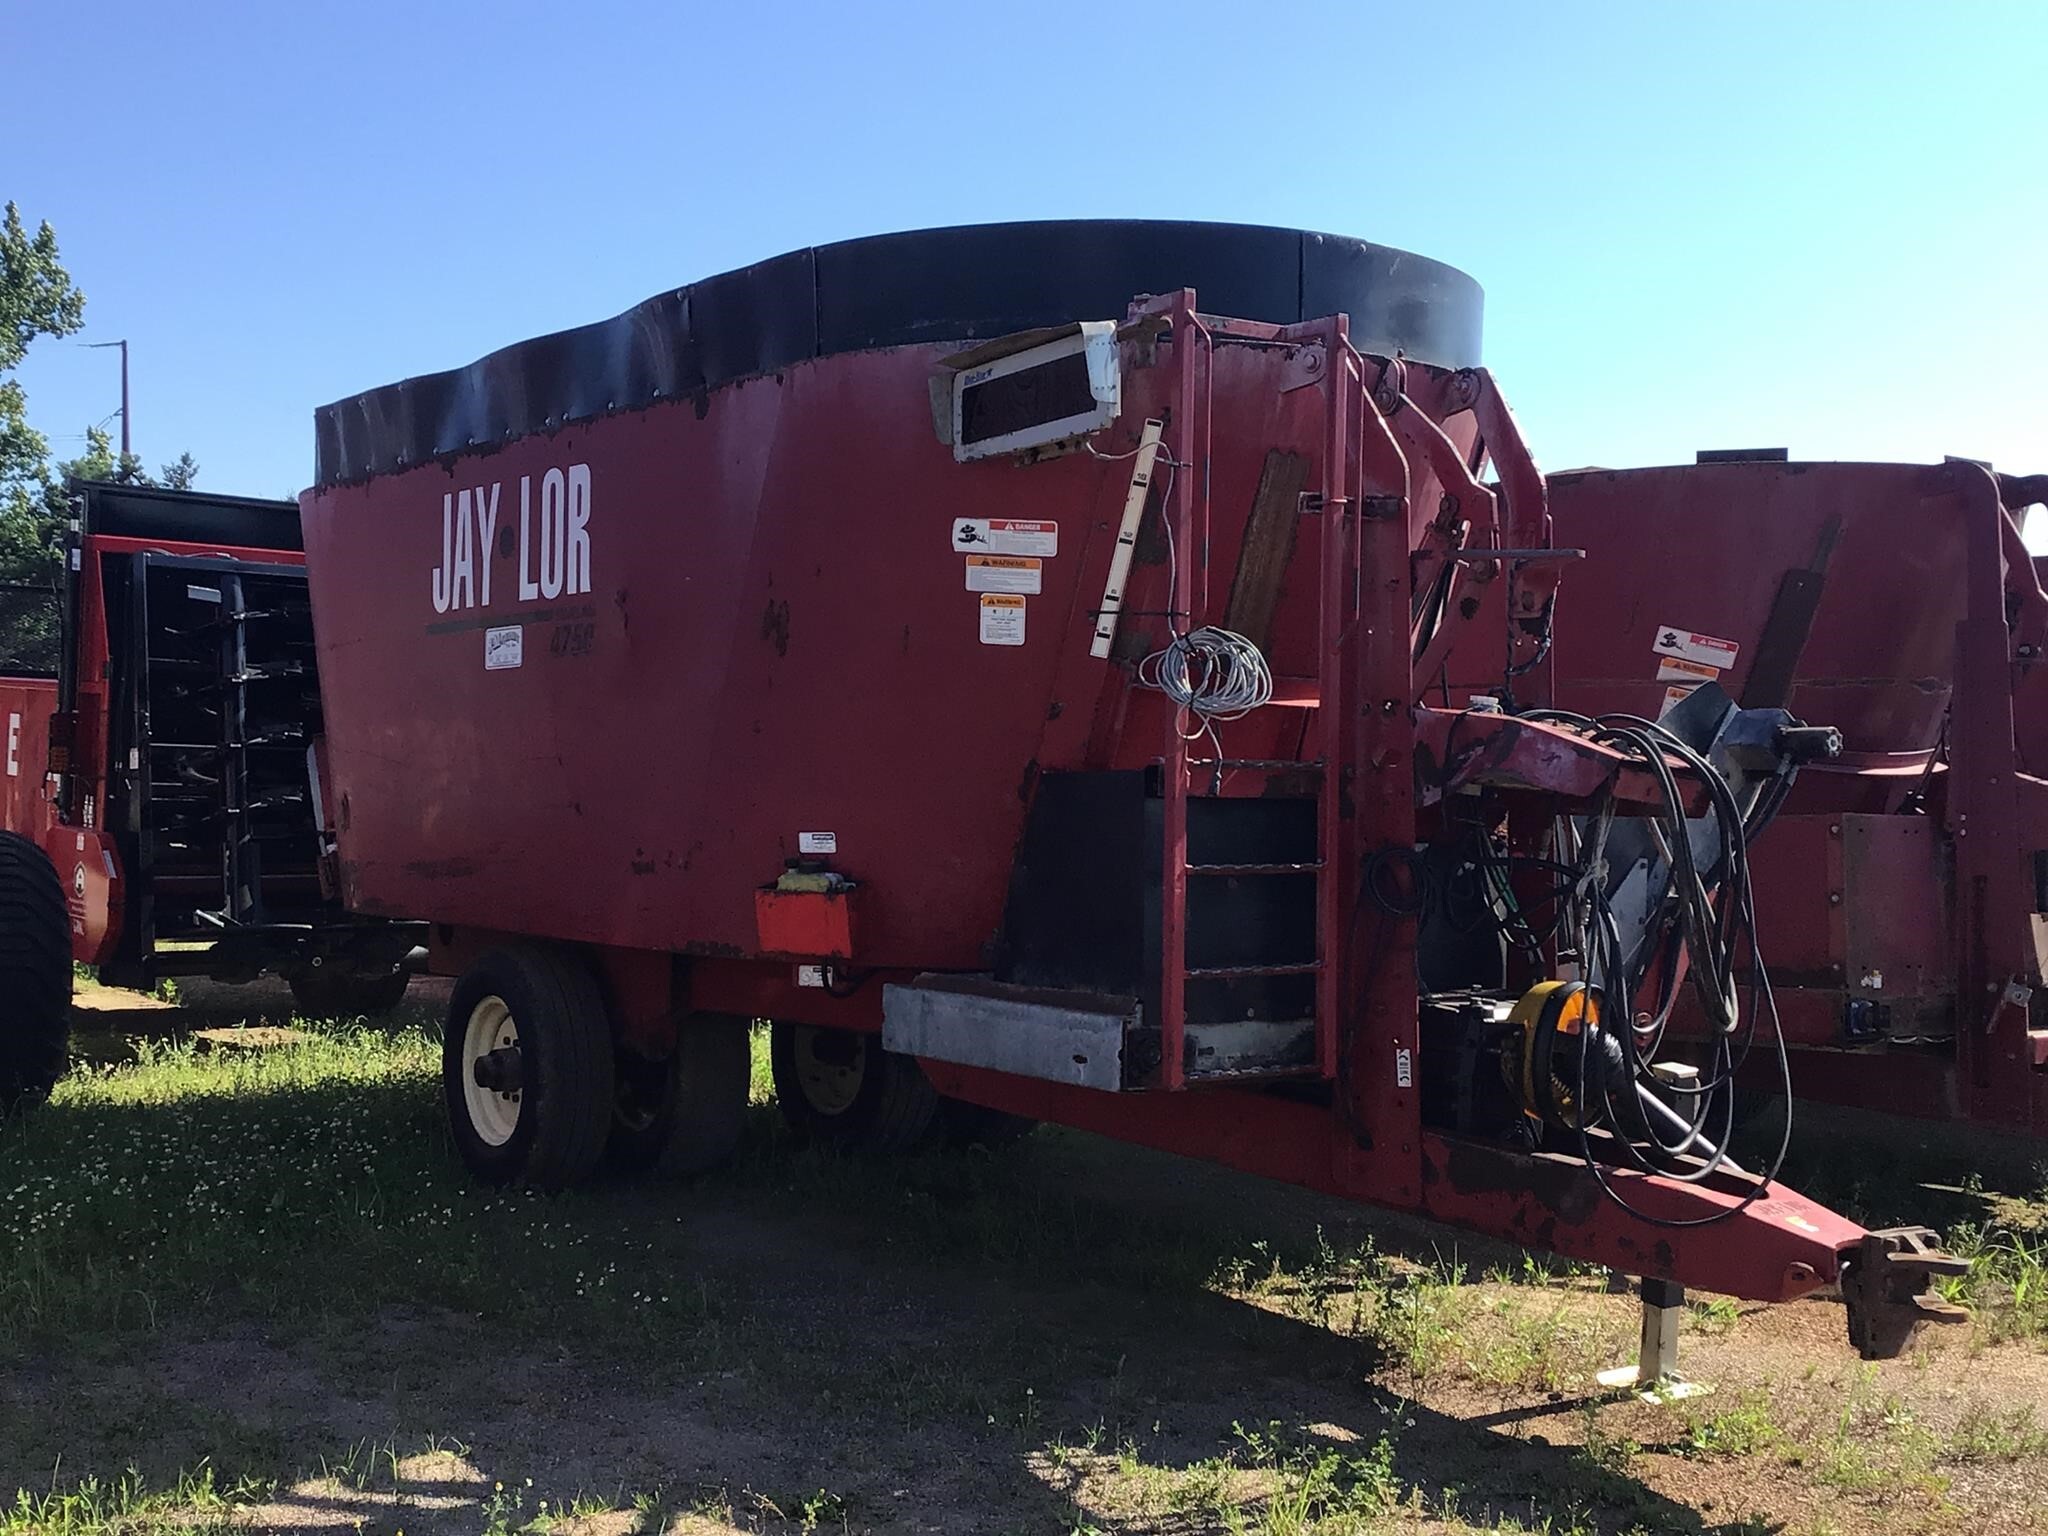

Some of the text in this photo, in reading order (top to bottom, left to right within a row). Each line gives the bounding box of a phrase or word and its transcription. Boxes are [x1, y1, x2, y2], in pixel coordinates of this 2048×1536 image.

[1014, 523, 1041, 531] DANGER
[432, 463, 591, 613] JAY LOR
[991, 559, 1027, 568] WARNING
